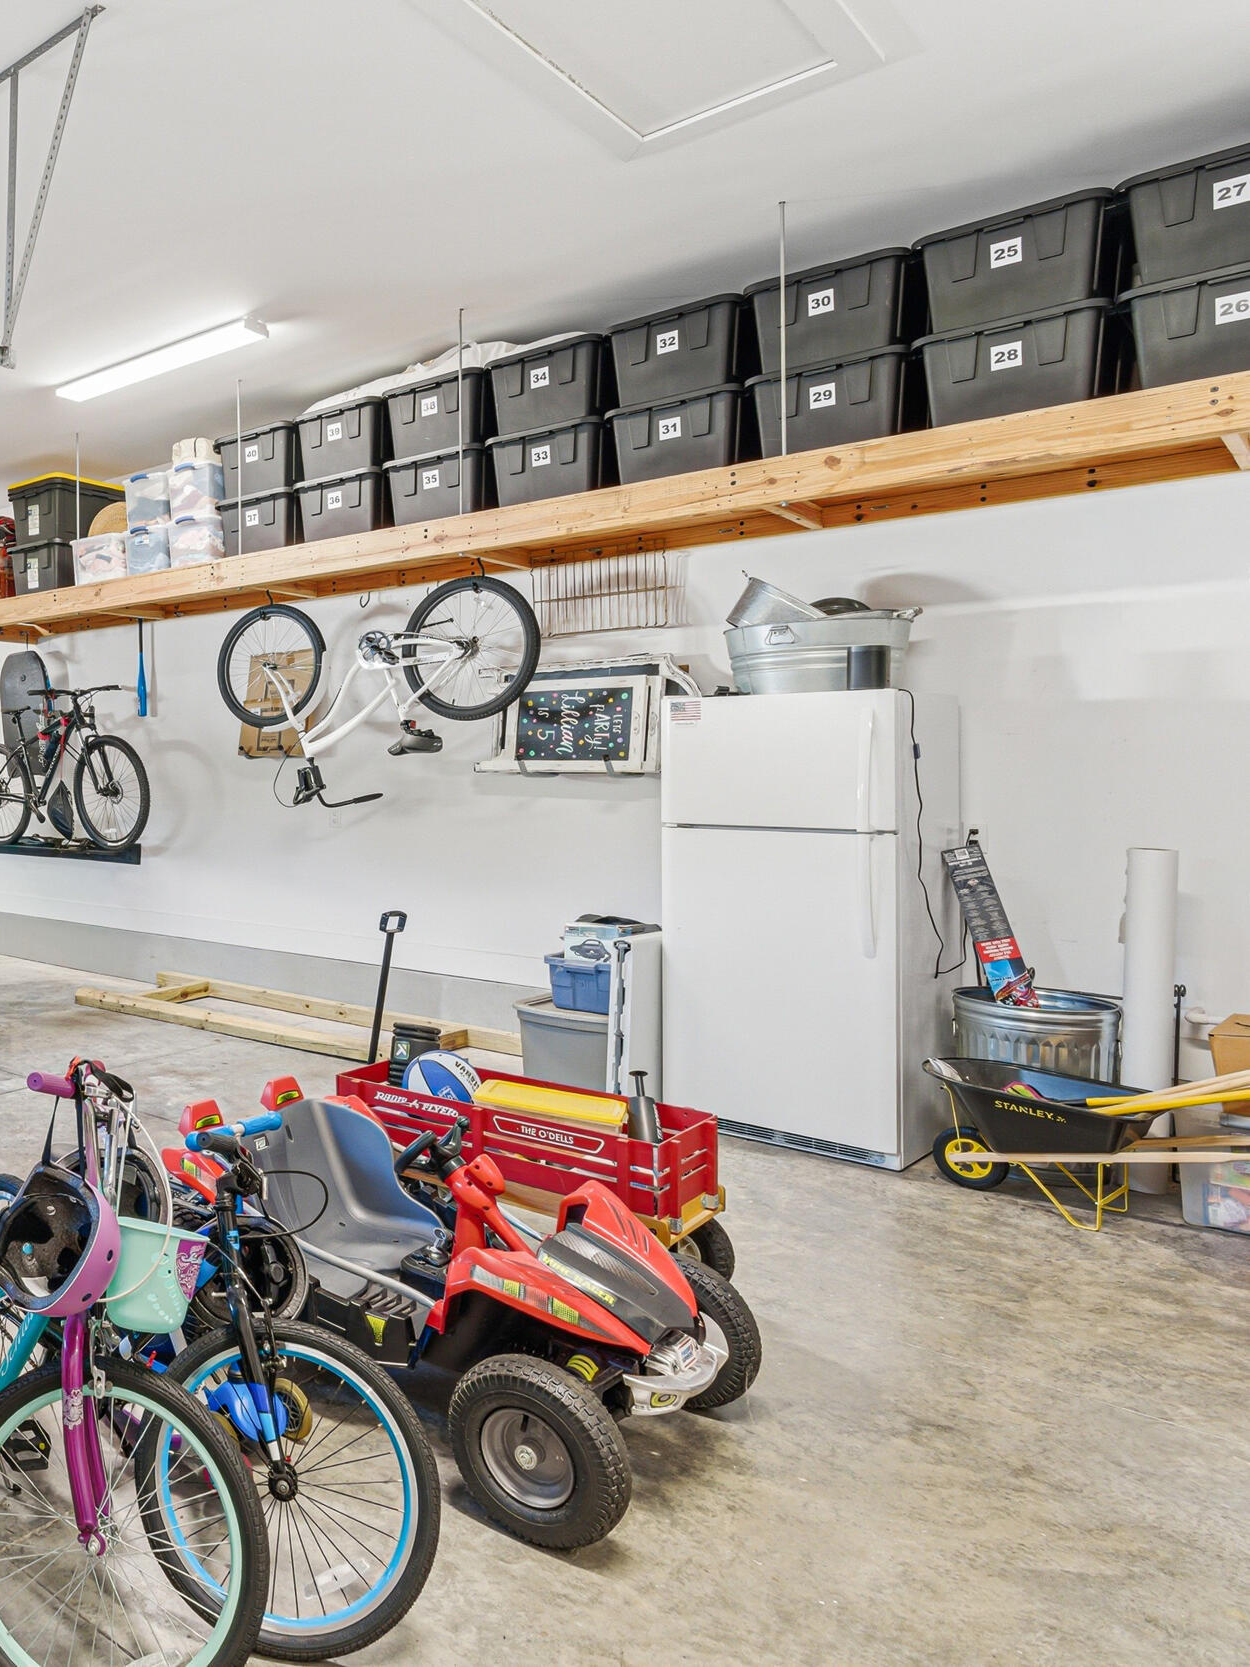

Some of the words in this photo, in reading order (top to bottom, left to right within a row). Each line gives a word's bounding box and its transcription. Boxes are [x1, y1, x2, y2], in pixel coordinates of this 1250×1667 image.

[1217, 181, 1248, 202] 27
[993, 243, 1019, 262] 25
[811, 295, 832, 310] 30
[1219, 299, 1250, 317] 26
[659, 335, 677, 349] 32
[993, 348, 1019, 365] 28
[532, 371, 548, 384] 34
[812, 389, 833, 404] 29
[423, 401, 436, 412] 38
[661, 422, 677, 435] 31
[246, 449, 257, 459] 40
[533, 450, 549, 462] 33
[424, 474, 438, 486] 35
[329, 495, 341, 505] 36
[246, 513, 258, 523] 37
[555, 691, 586, 755] Lillian
[536, 728, 556, 741] 5
[521, 1125, 537, 1137] THE
[538, 1129, 575, 1145] O'DELLS
